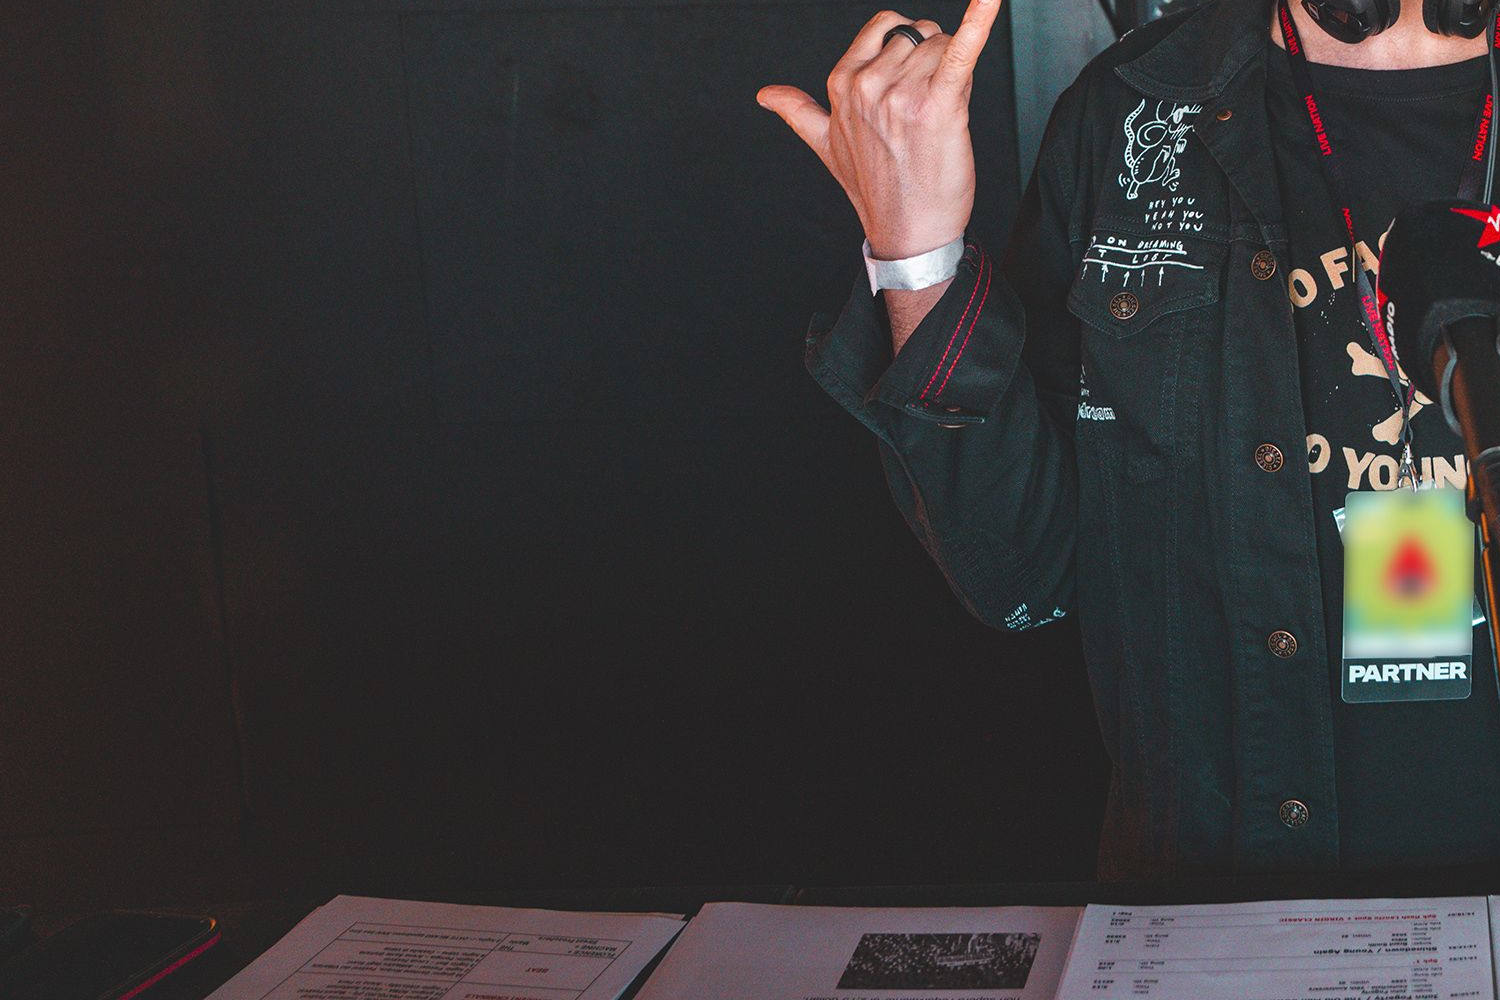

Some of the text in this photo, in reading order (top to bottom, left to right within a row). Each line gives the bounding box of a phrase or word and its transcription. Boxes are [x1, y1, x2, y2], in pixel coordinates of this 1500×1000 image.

[1286, 36, 1300, 56] LIVE
[1304, 94, 1333, 157] LIVE NATION
[1472, 94, 1493, 161] LIVE NATION
[1148, 196, 1196, 210] HEY YOU
[1144, 210, 1204, 223] YEAH YOU
[1151, 222, 1203, 232] NOT YOU
[1106, 236, 1128, 246] ON
[1137, 240, 1184, 252] DREAMING
[1320, 231, 1388, 290] FA
[1361, 295, 1395, 371] LIVE NATION
[1348, 662, 1468, 684] PARTNER
